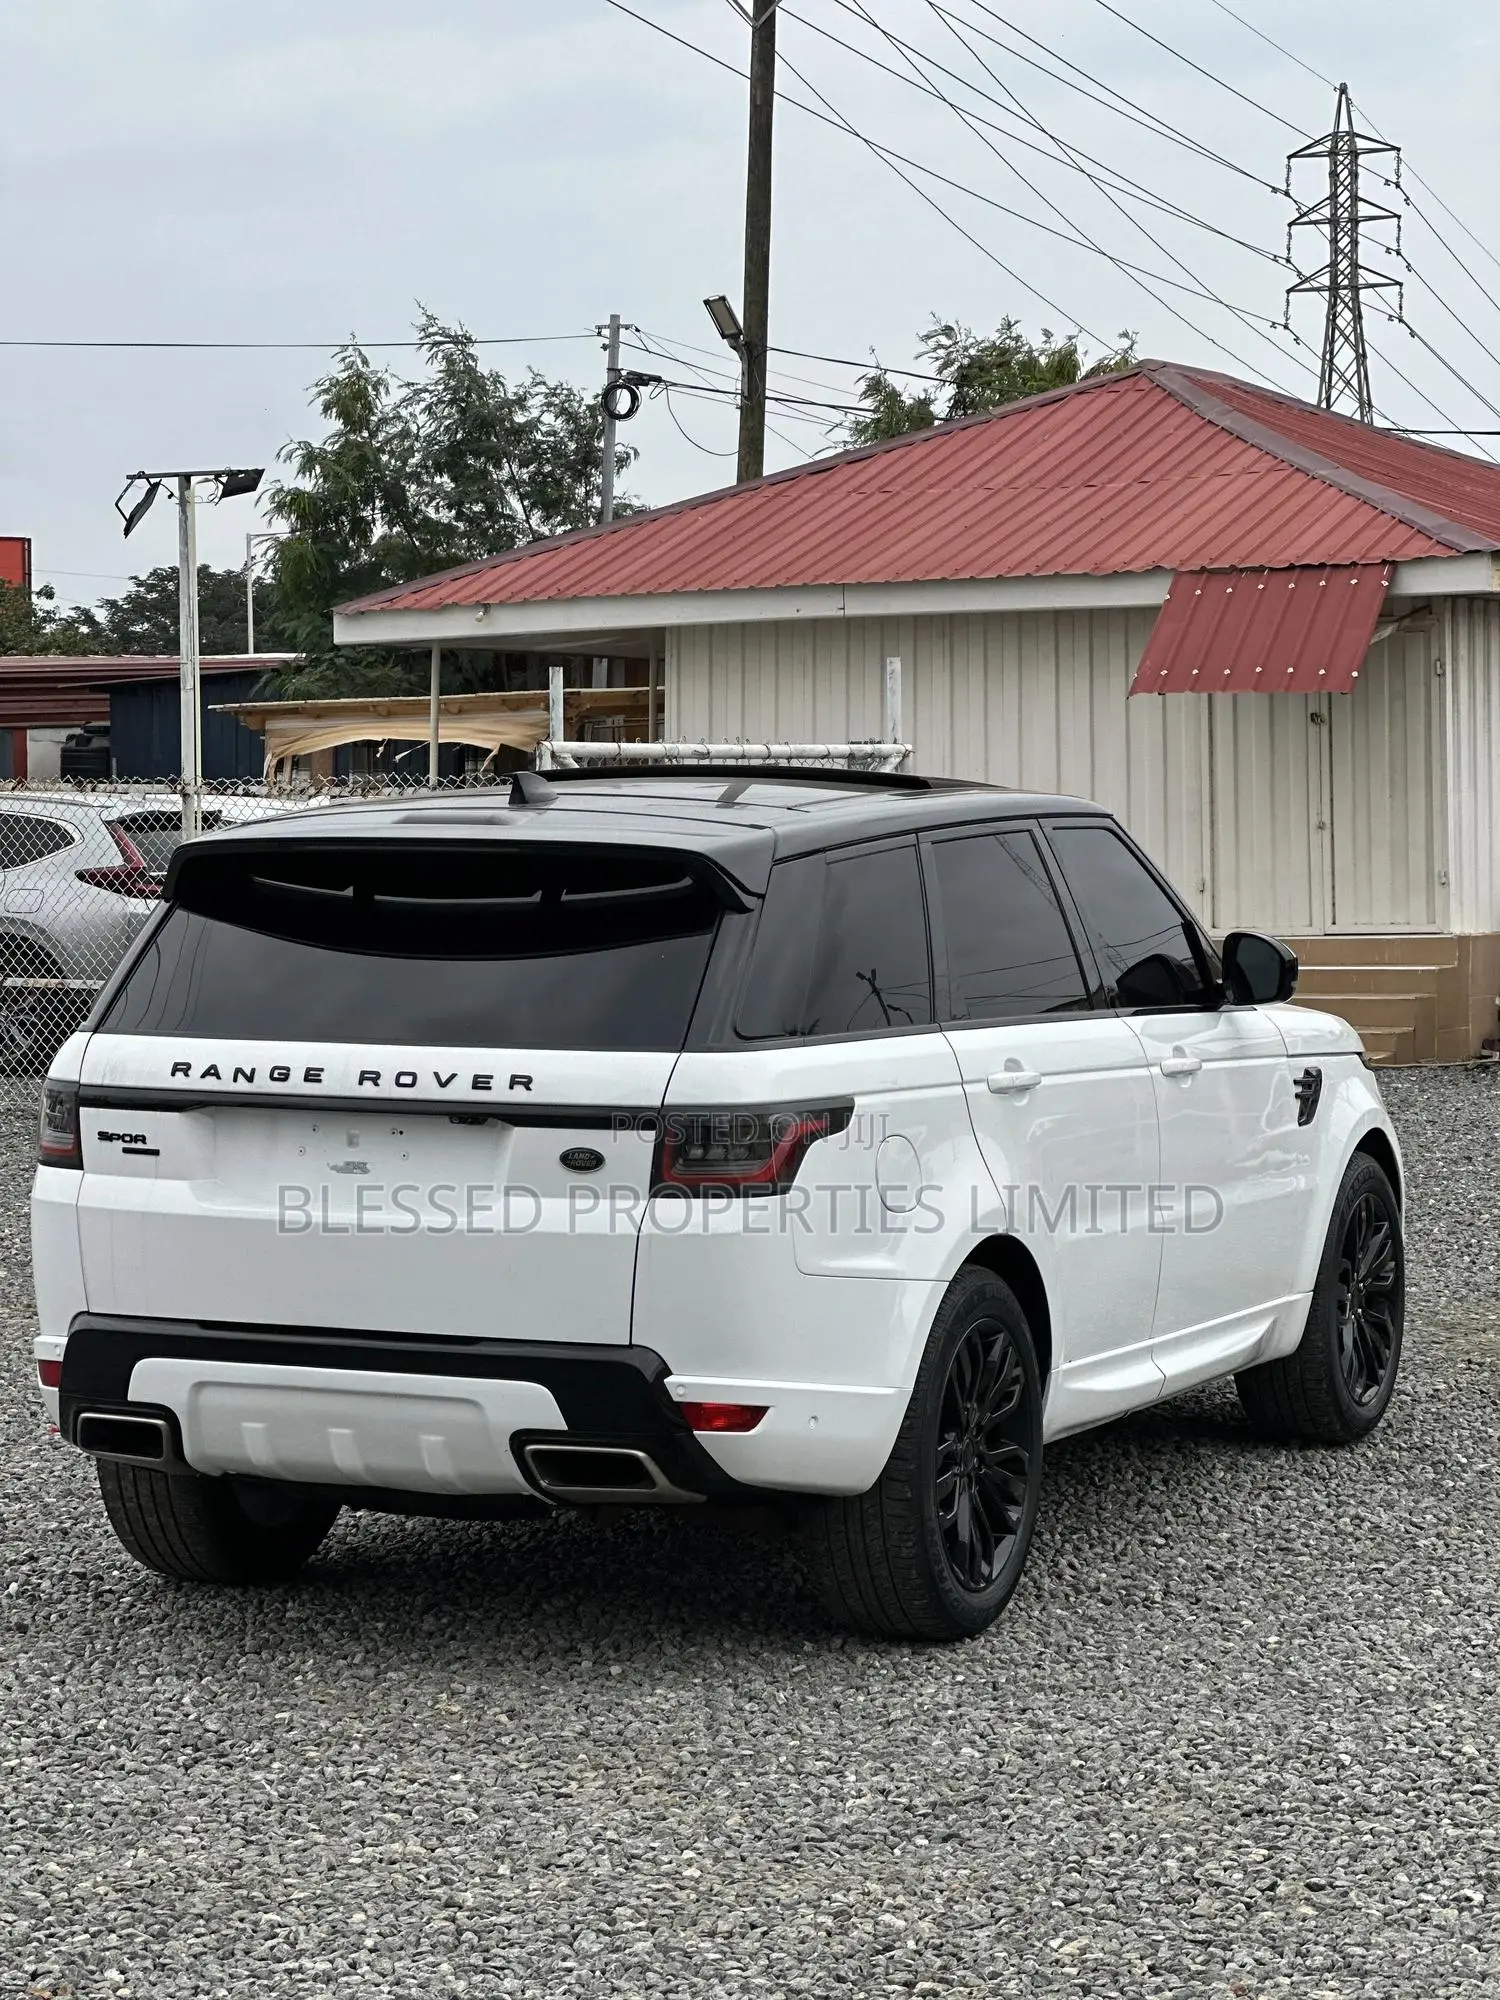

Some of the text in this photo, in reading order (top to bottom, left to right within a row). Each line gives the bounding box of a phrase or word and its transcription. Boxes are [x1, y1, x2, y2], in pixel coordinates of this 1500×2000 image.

[170, 1061, 534, 1092] RANGE ROVER
[97, 1130, 148, 1145] SPOR
[568, 1152, 590, 1160] LAND
